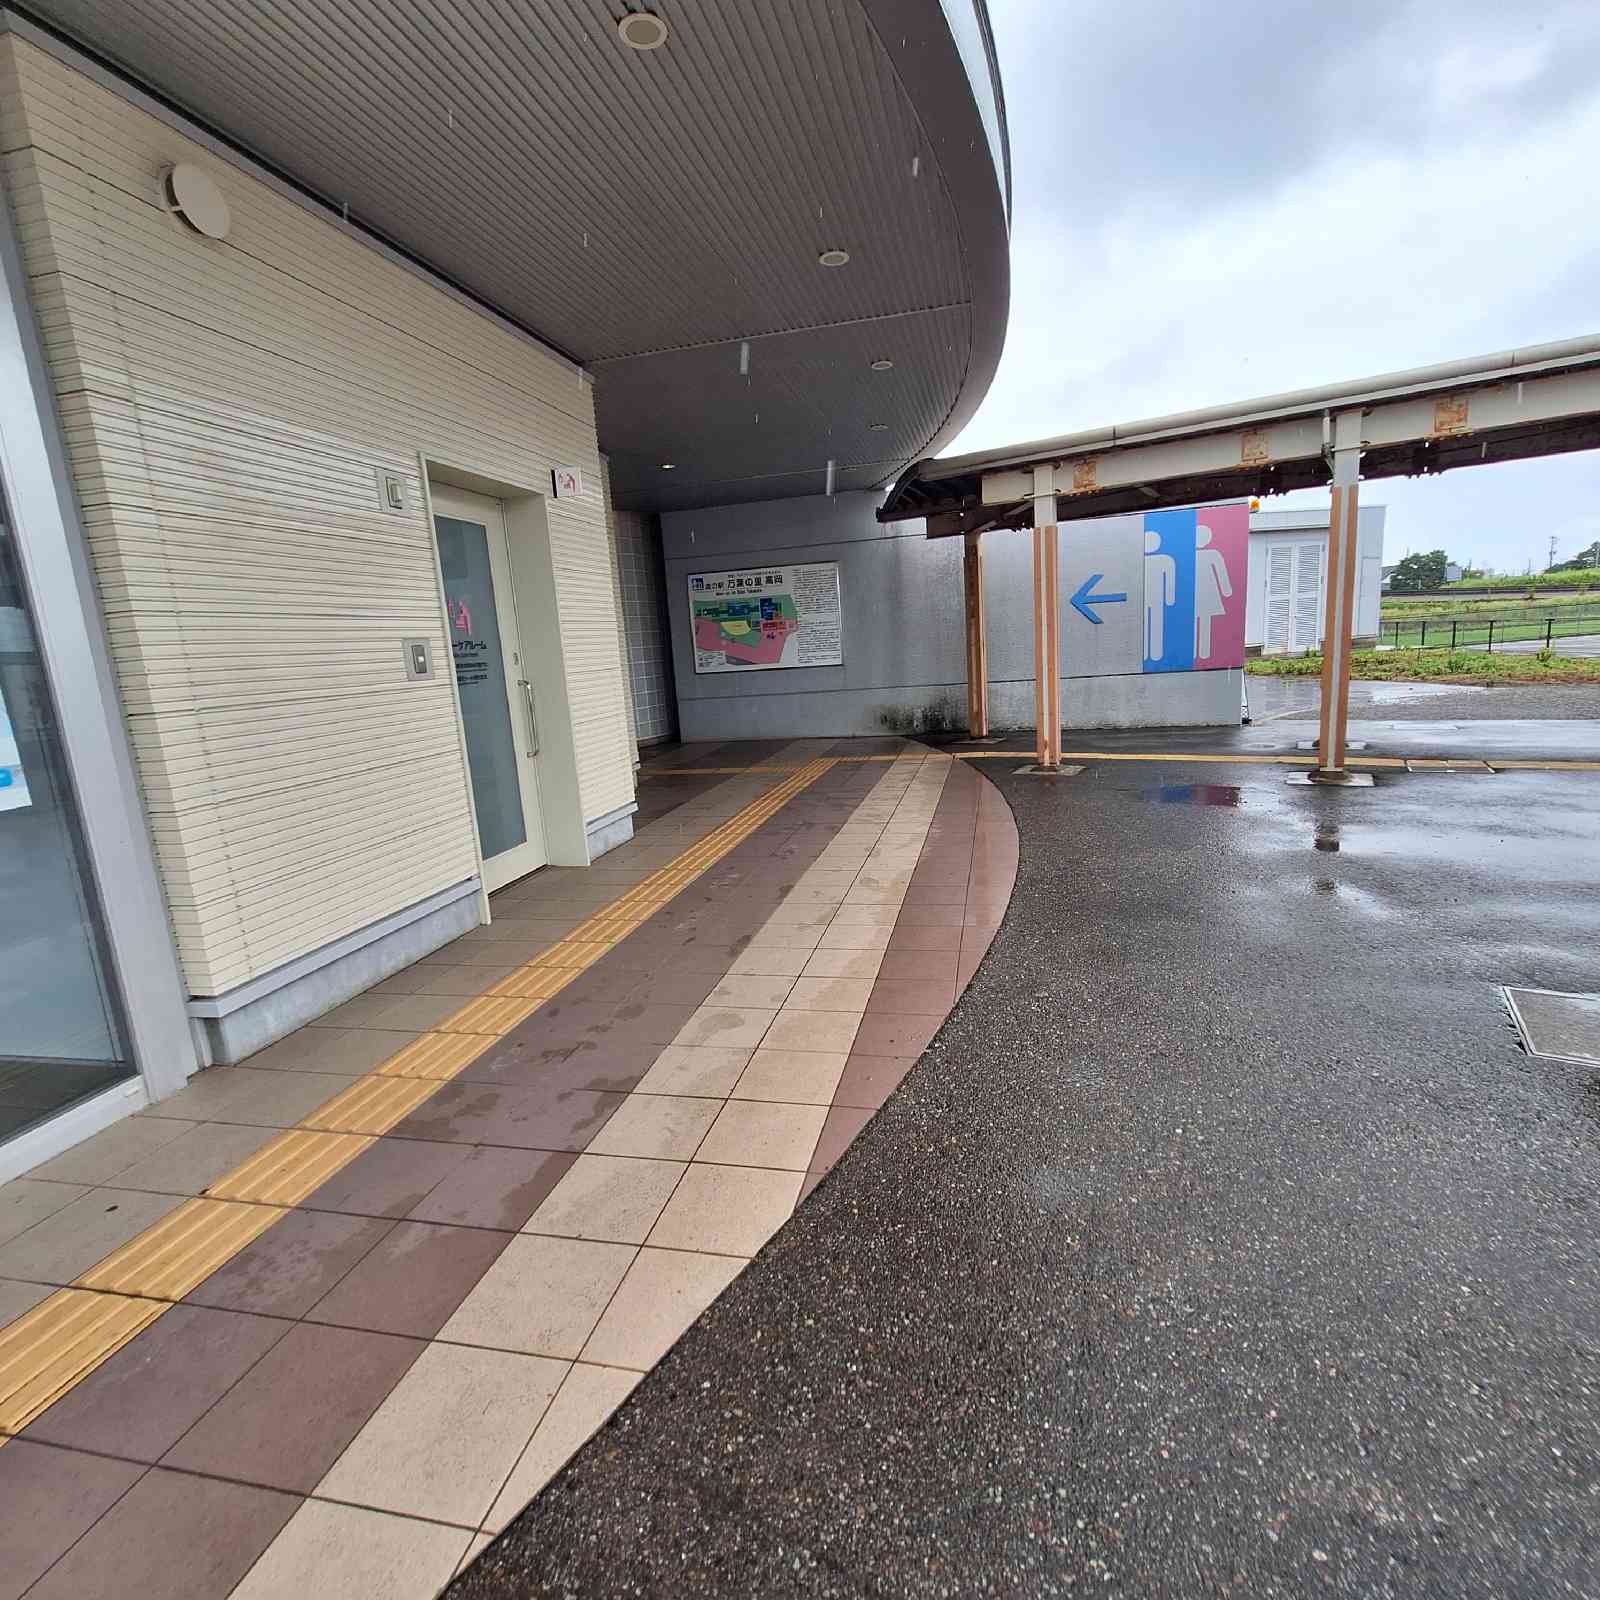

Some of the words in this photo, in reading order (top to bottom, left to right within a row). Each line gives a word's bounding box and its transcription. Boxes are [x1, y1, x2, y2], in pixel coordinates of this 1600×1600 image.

[452, 640, 487, 650] ーケアルーム
